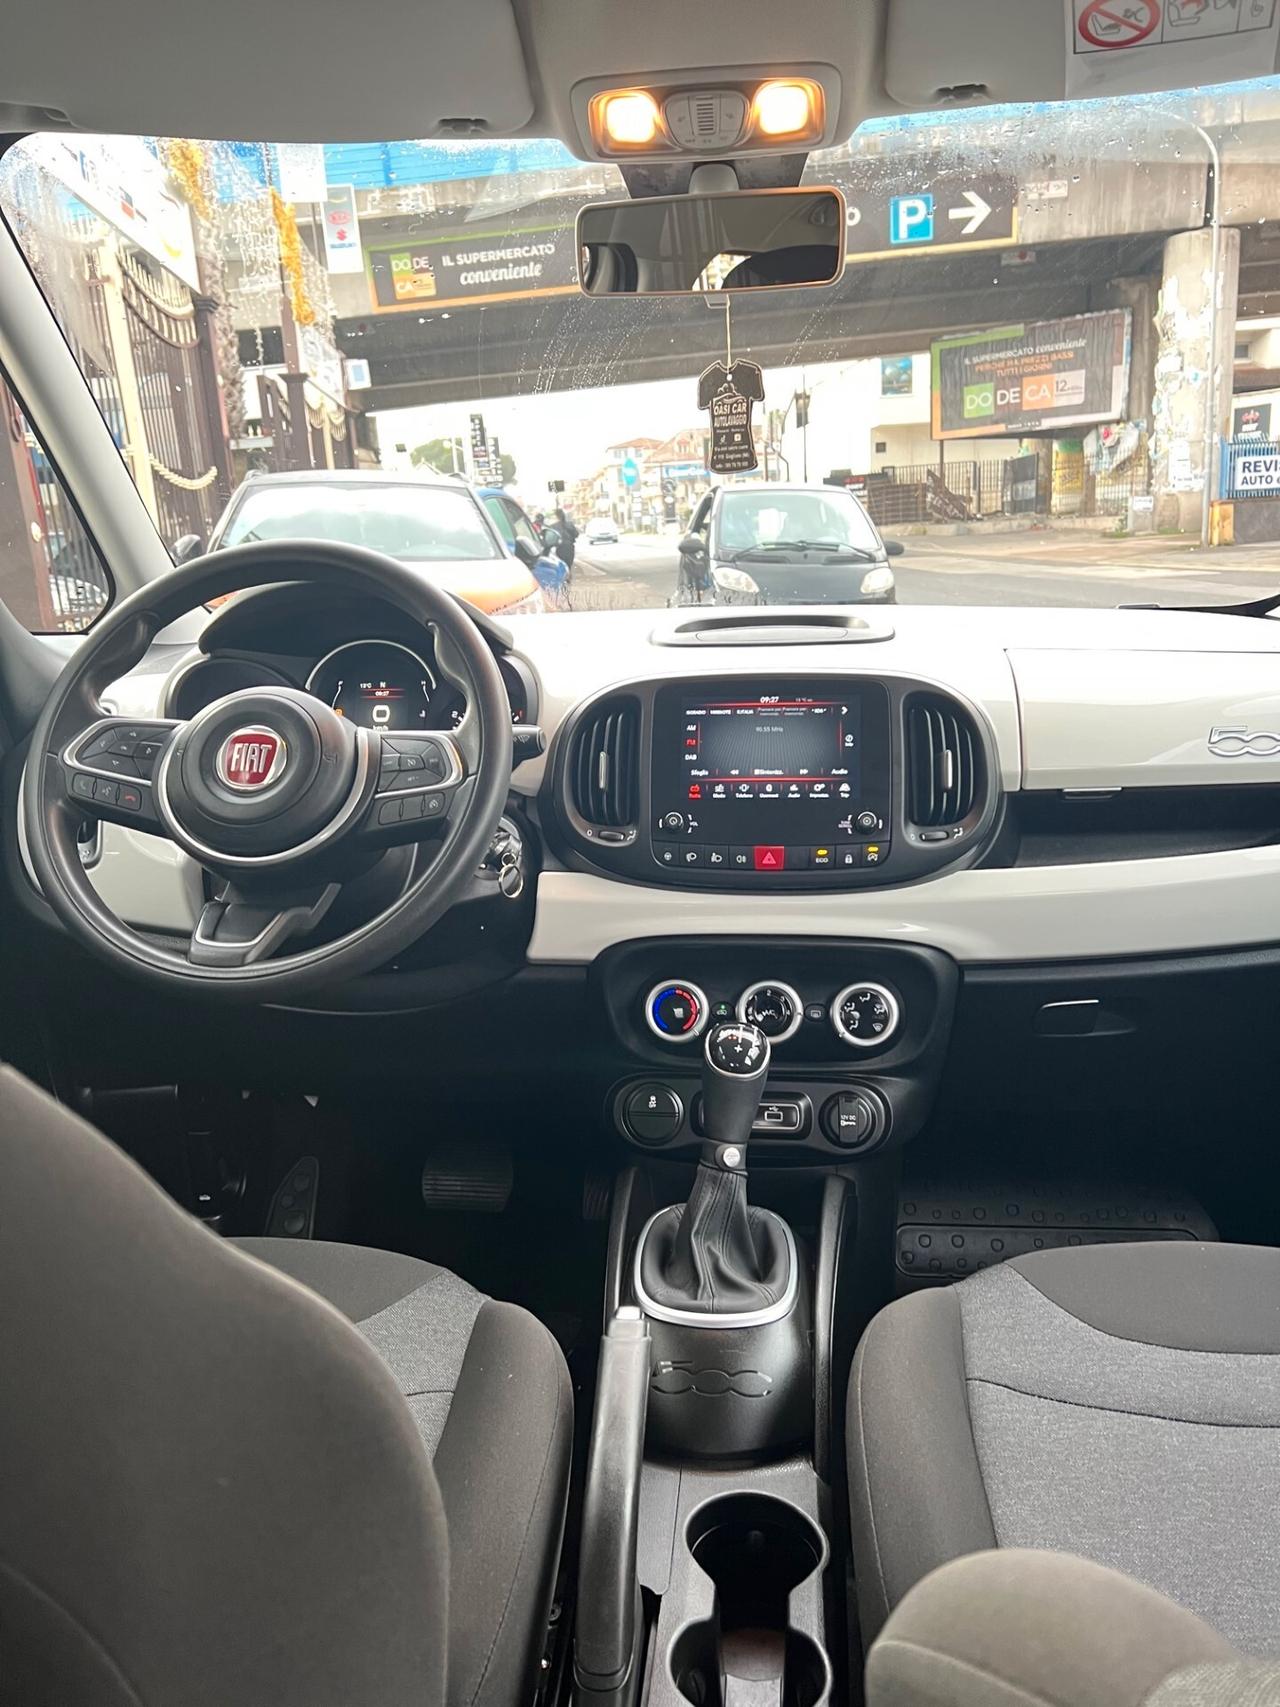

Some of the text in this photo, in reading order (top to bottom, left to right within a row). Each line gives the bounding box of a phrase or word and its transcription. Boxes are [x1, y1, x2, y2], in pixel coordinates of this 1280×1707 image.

[898, 198, 928, 239] P
[442, 243, 555, 267] IL SUPERMERCATO
[392, 256, 429, 272] DO DE
[460, 262, 543, 286] conveniente
[971, 346, 1034, 364] SUPERMERCATO
[1035, 338, 1088, 354] conveniente
[996, 366, 1018, 377] TUTTI
[966, 392, 993, 410] DO
[996, 387, 1021, 406] DE
[1024, 384, 1052, 401] CA
[714, 414, 747, 428] AUTOLAVAGGIO
[1242, 459, 1280, 473] REVI
[1241, 474, 1273, 486] AUTO
[759, 696, 780, 704] 09:27
[230, 743, 272, 773] FIAT
[815, 856, 829, 864] ECO
